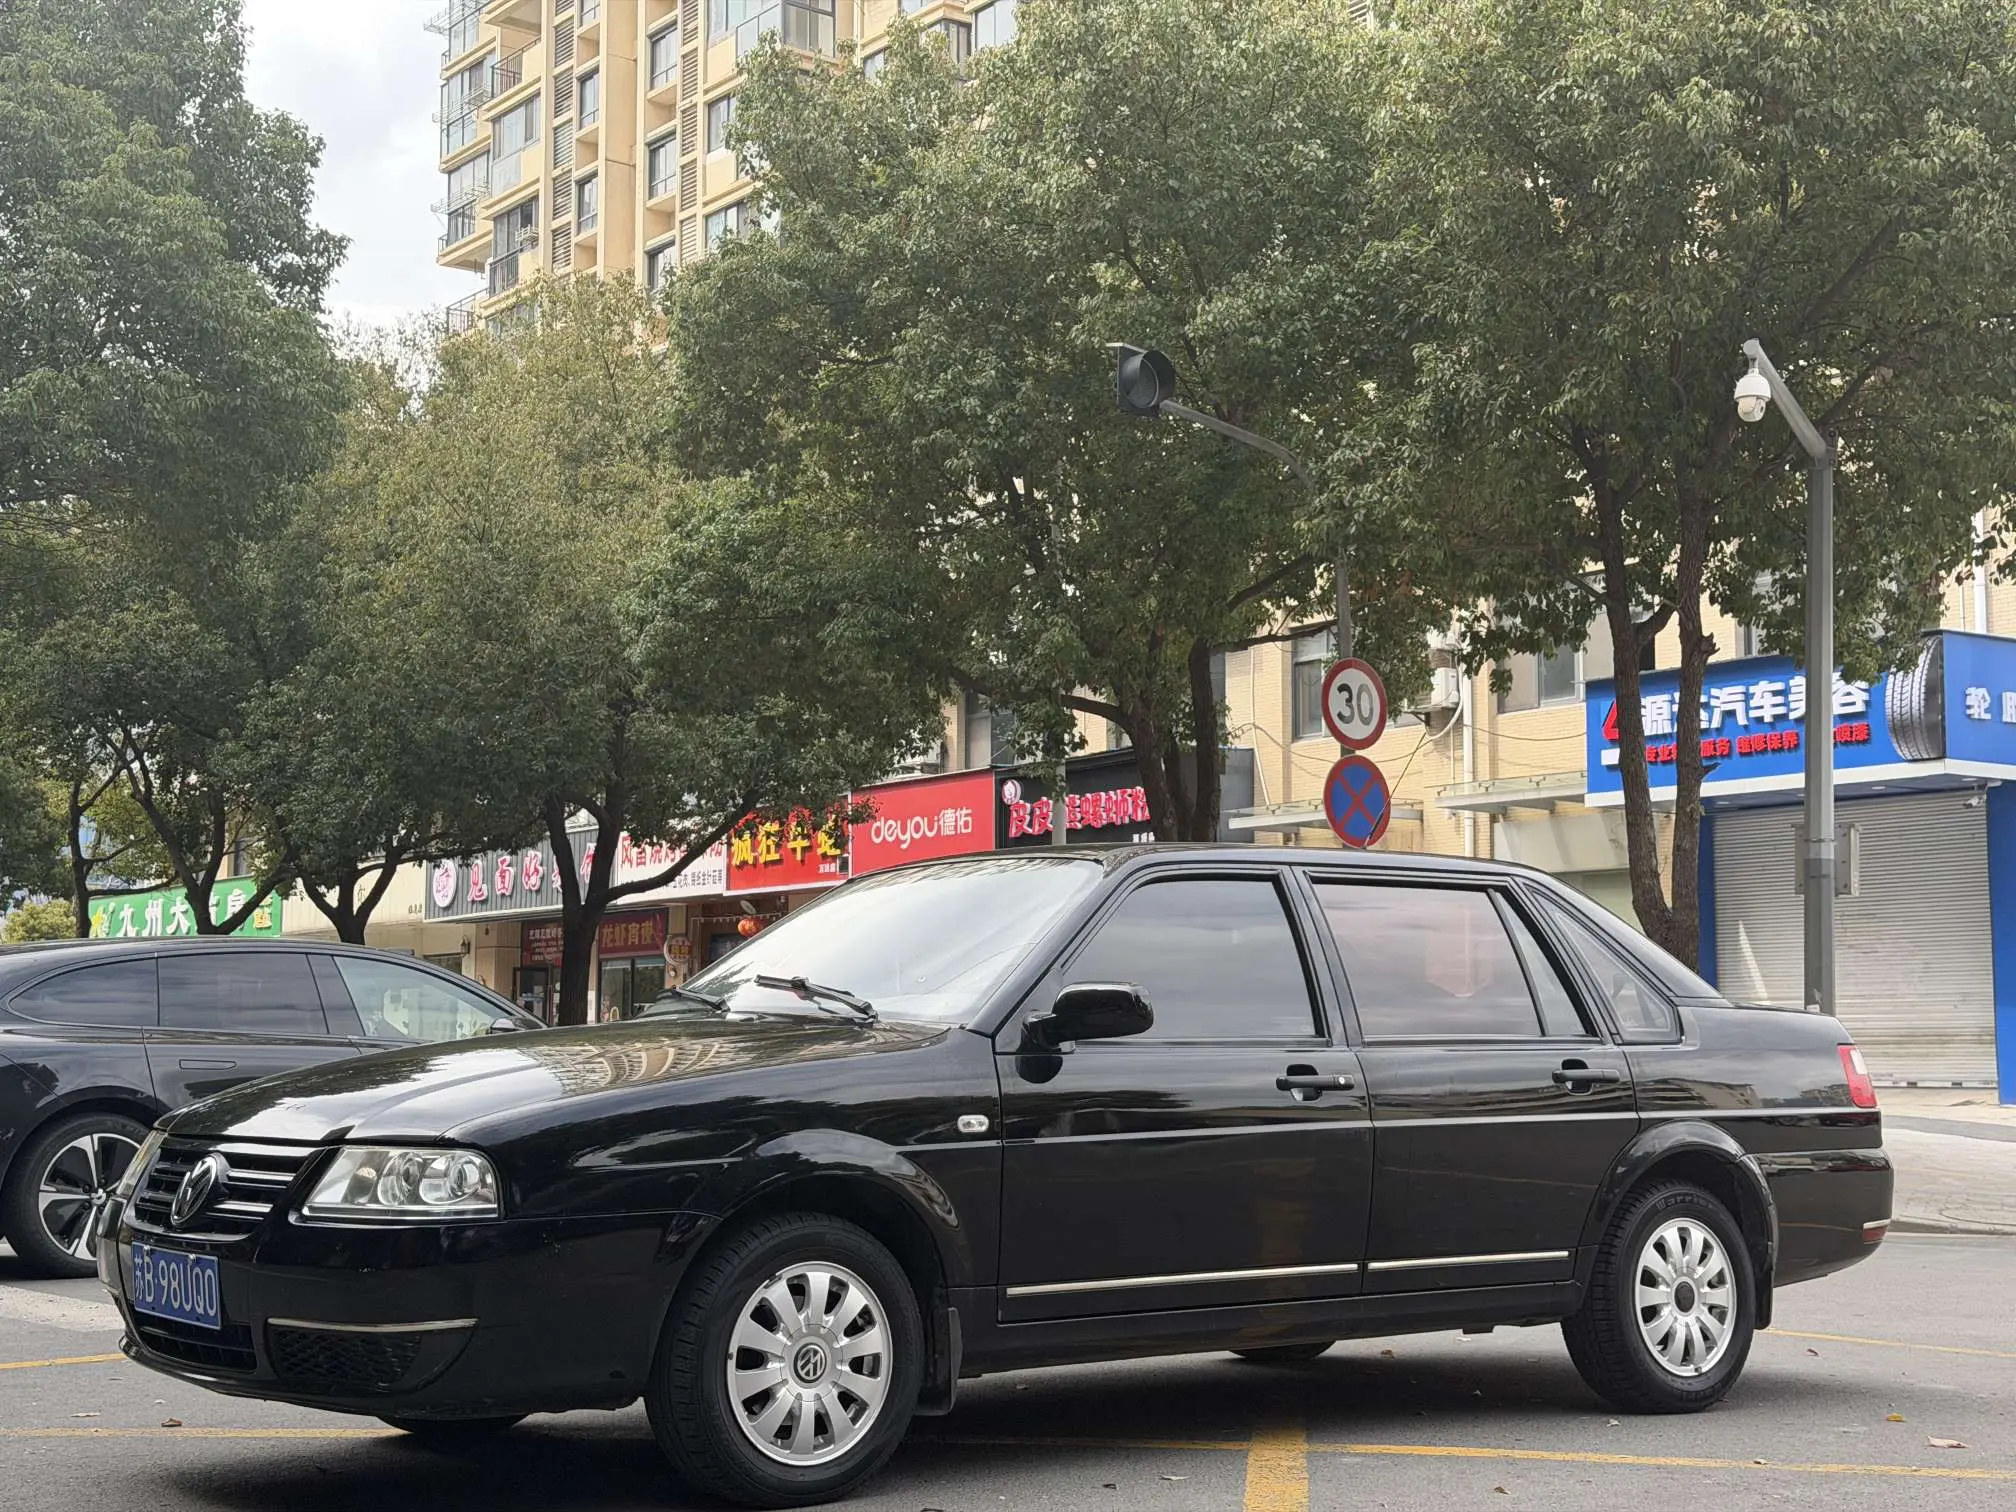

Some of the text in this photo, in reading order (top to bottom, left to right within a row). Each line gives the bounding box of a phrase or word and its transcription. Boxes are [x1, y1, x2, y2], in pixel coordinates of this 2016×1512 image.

[1336, 682, 1374, 727] 30
[1640, 671, 1870, 737] 源汽车容
